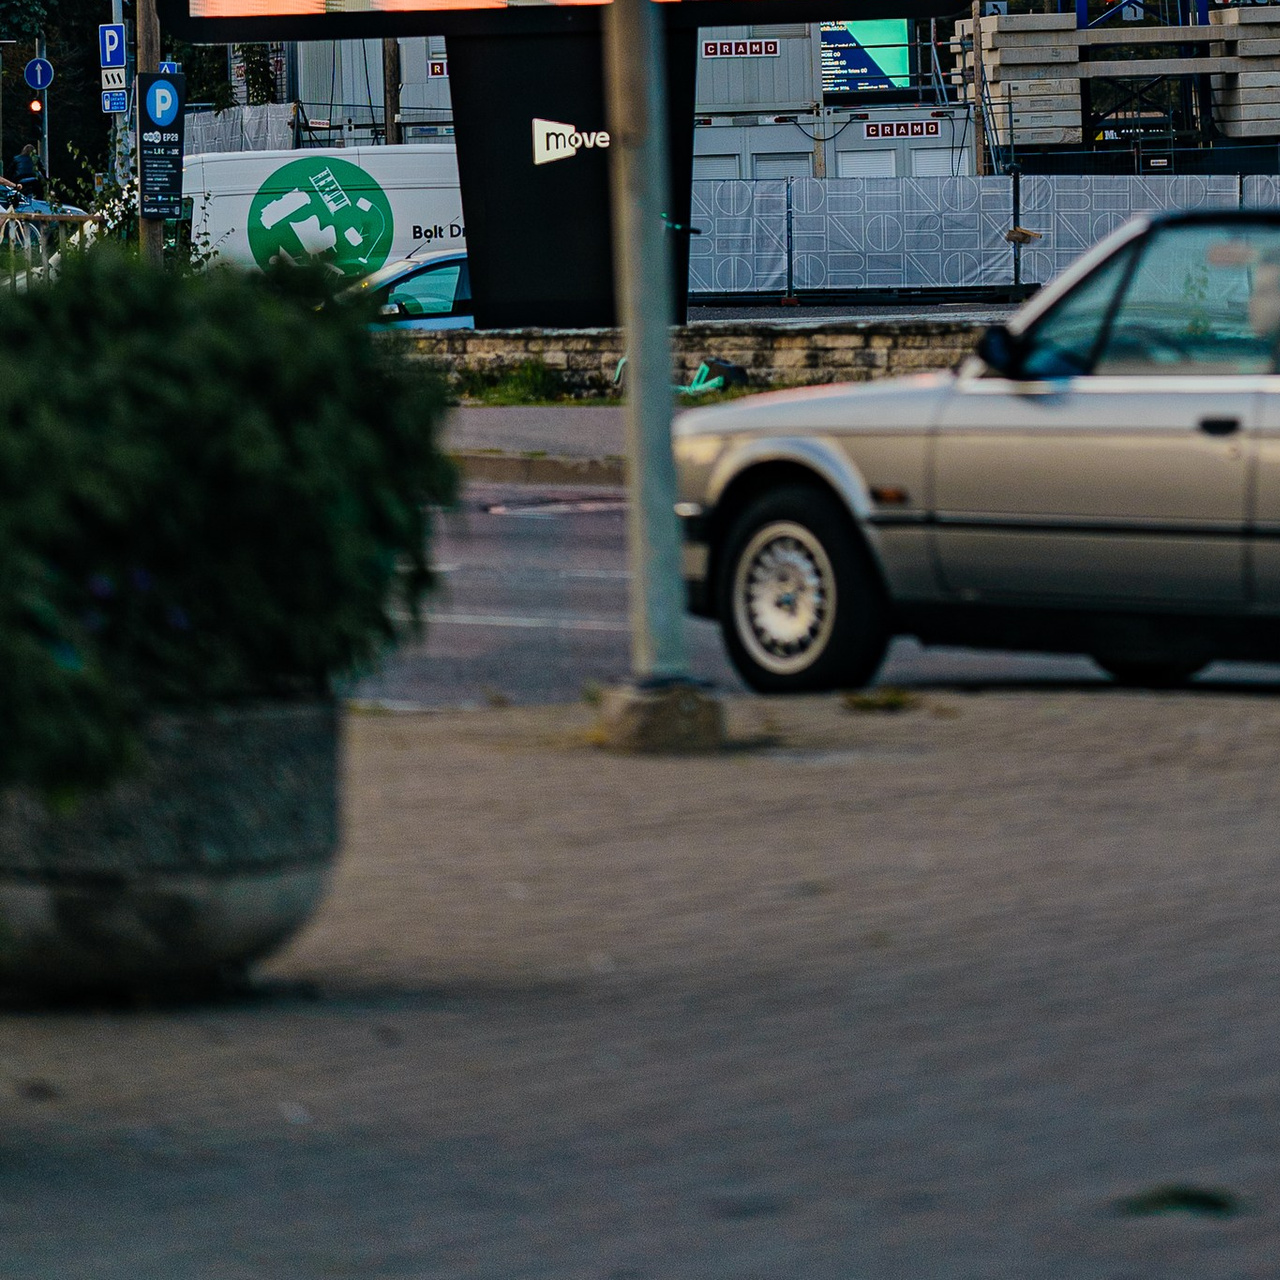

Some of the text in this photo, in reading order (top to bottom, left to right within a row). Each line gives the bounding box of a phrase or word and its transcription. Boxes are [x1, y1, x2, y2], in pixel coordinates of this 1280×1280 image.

[706, 42, 775, 55] CRAMO
[155, 89, 172, 119] P
[868, 123, 937, 136] CRAMO
[546, 131, 611, 151] move
[412, 224, 444, 239] Bolt
